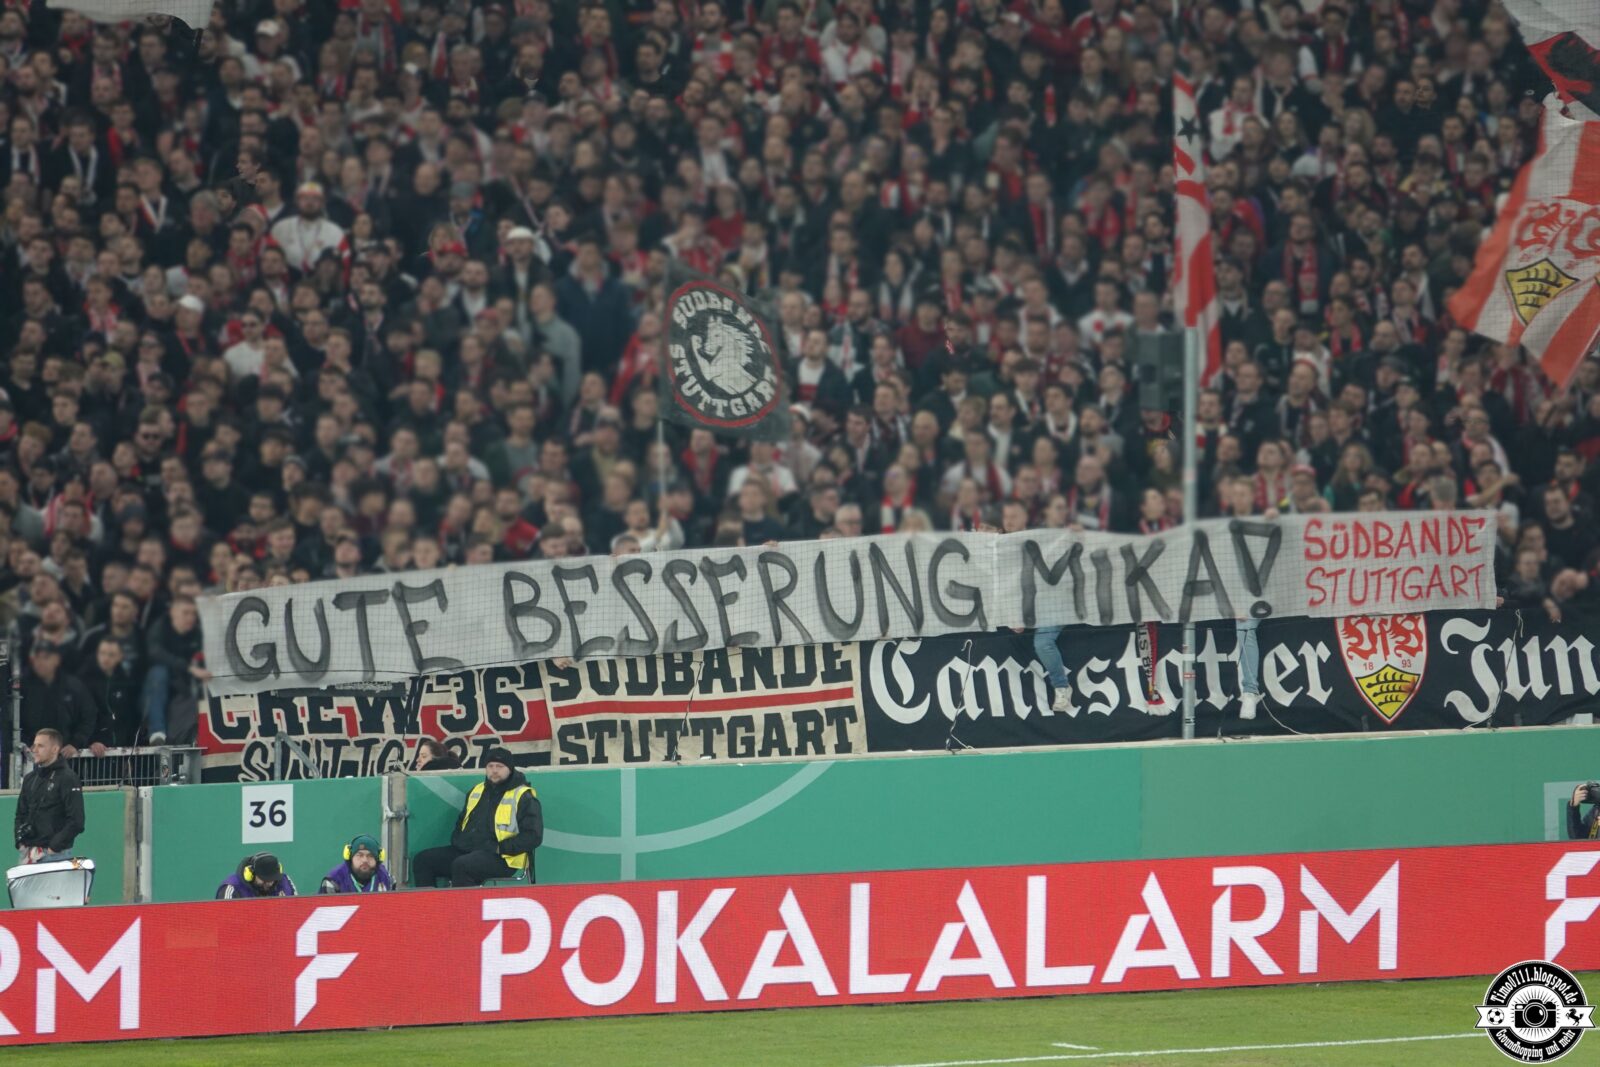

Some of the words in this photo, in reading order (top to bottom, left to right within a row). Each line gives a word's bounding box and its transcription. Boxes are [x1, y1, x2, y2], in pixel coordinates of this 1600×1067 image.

[669, 344, 778, 417] STUTTGART
[1303, 515, 1486, 561] SÜDBANDE
[224, 577, 464, 684] GUTE
[503, 537, 988, 663] BESSERUNG
[1022, 518, 1283, 629] MIKA!
[1305, 563, 1486, 608] STUTTGART
[1362, 662, 1374, 671] 18
[1401, 659, 1412, 668] 93
[432, 664, 532, 736] 36
[557, 704, 858, 765] STUTTGART
[249, 801, 287, 828] 36
[0, 916, 142, 1036] M
[480, 859, 1400, 1012] POKALALARM
